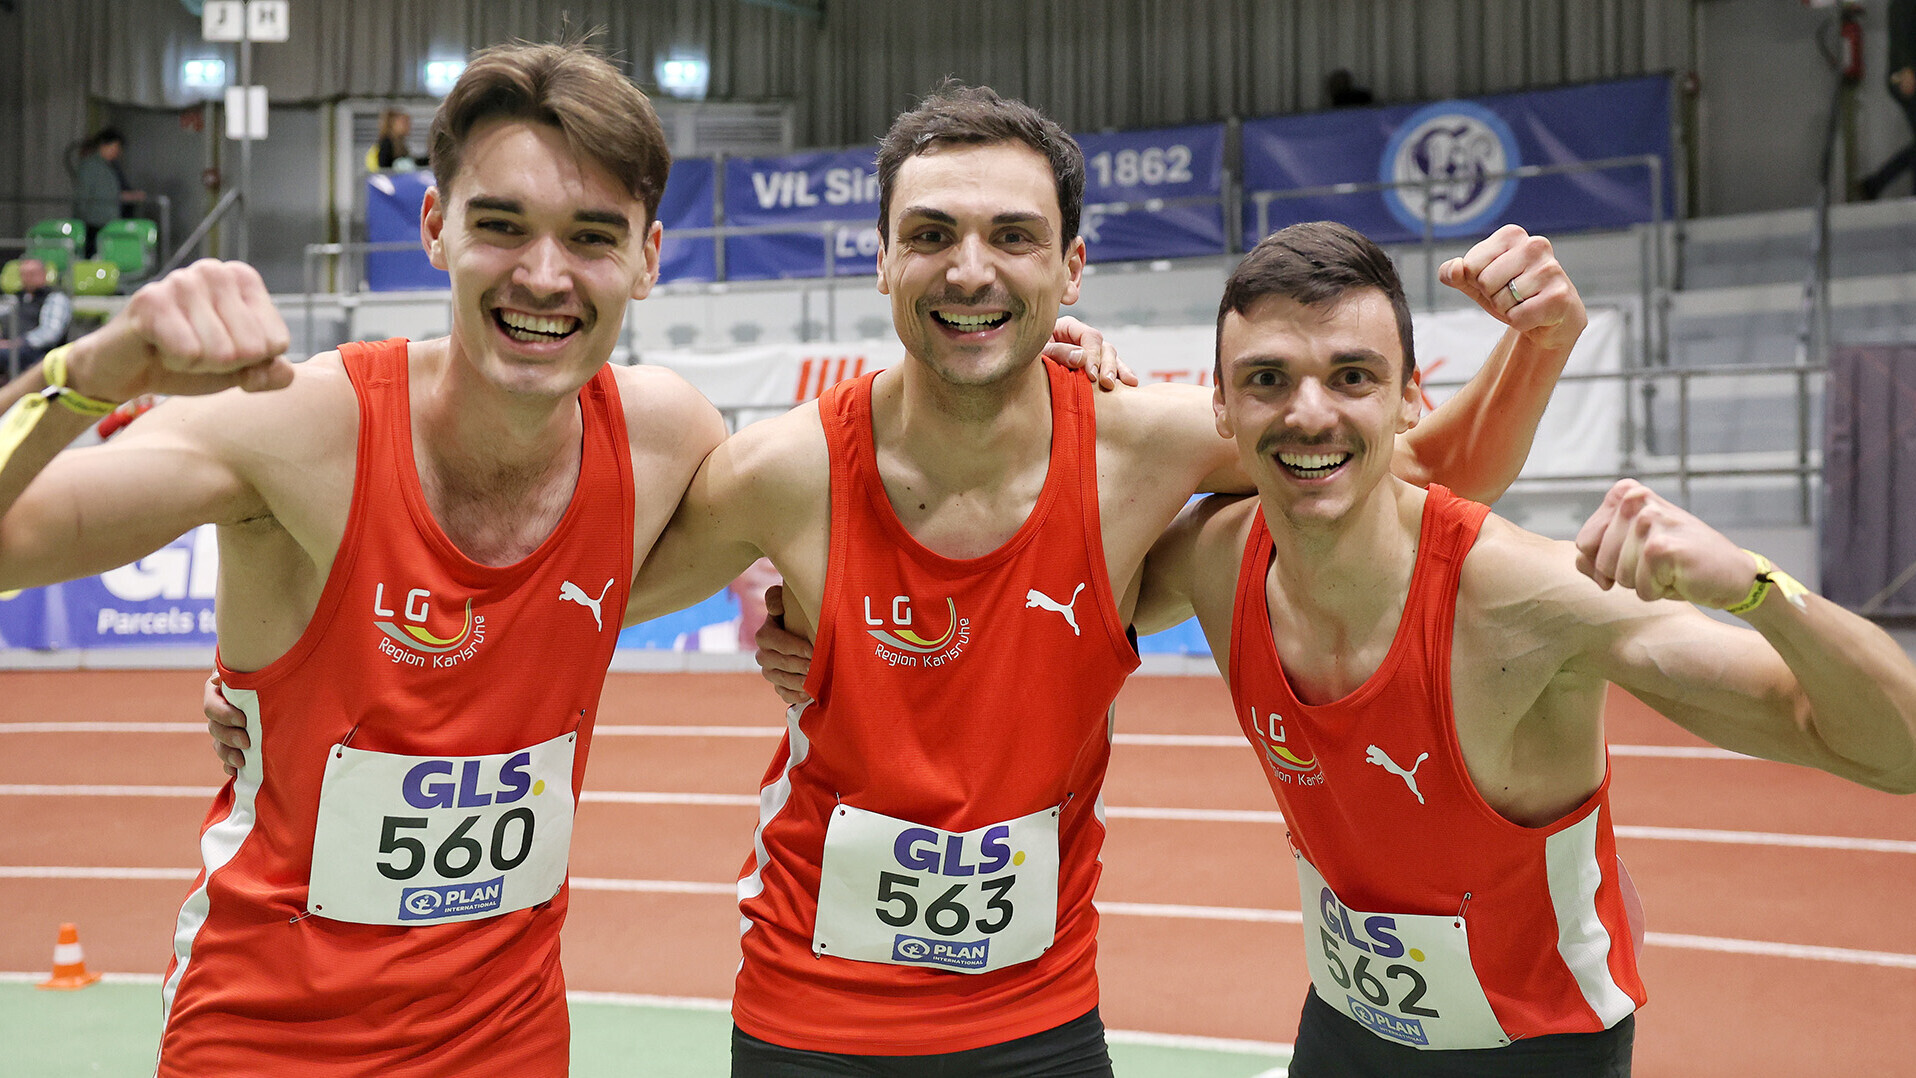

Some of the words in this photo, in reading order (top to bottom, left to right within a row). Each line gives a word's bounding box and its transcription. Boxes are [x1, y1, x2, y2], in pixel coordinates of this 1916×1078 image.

[752, 171, 820, 208] VfL
[1089, 144, 1193, 188] 1862
[97, 606, 195, 634] Parcels
[378, 636, 425, 667] Region
[432, 615, 485, 668] Karlsruhe
[874, 643, 917, 667] Region
[922, 617, 971, 667] Karlsruhe
[376, 807, 535, 880] 560
[444, 901, 498, 913] INTERNATIONAL
[445, 884, 500, 905] PLAN
[875, 870, 1016, 936] 563
[932, 955, 984, 966] INTERNATIONAL
[934, 944, 985, 959] PLAN
[1320, 925, 1441, 1018] 562
[1375, 1013, 1421, 1037] PLAN
